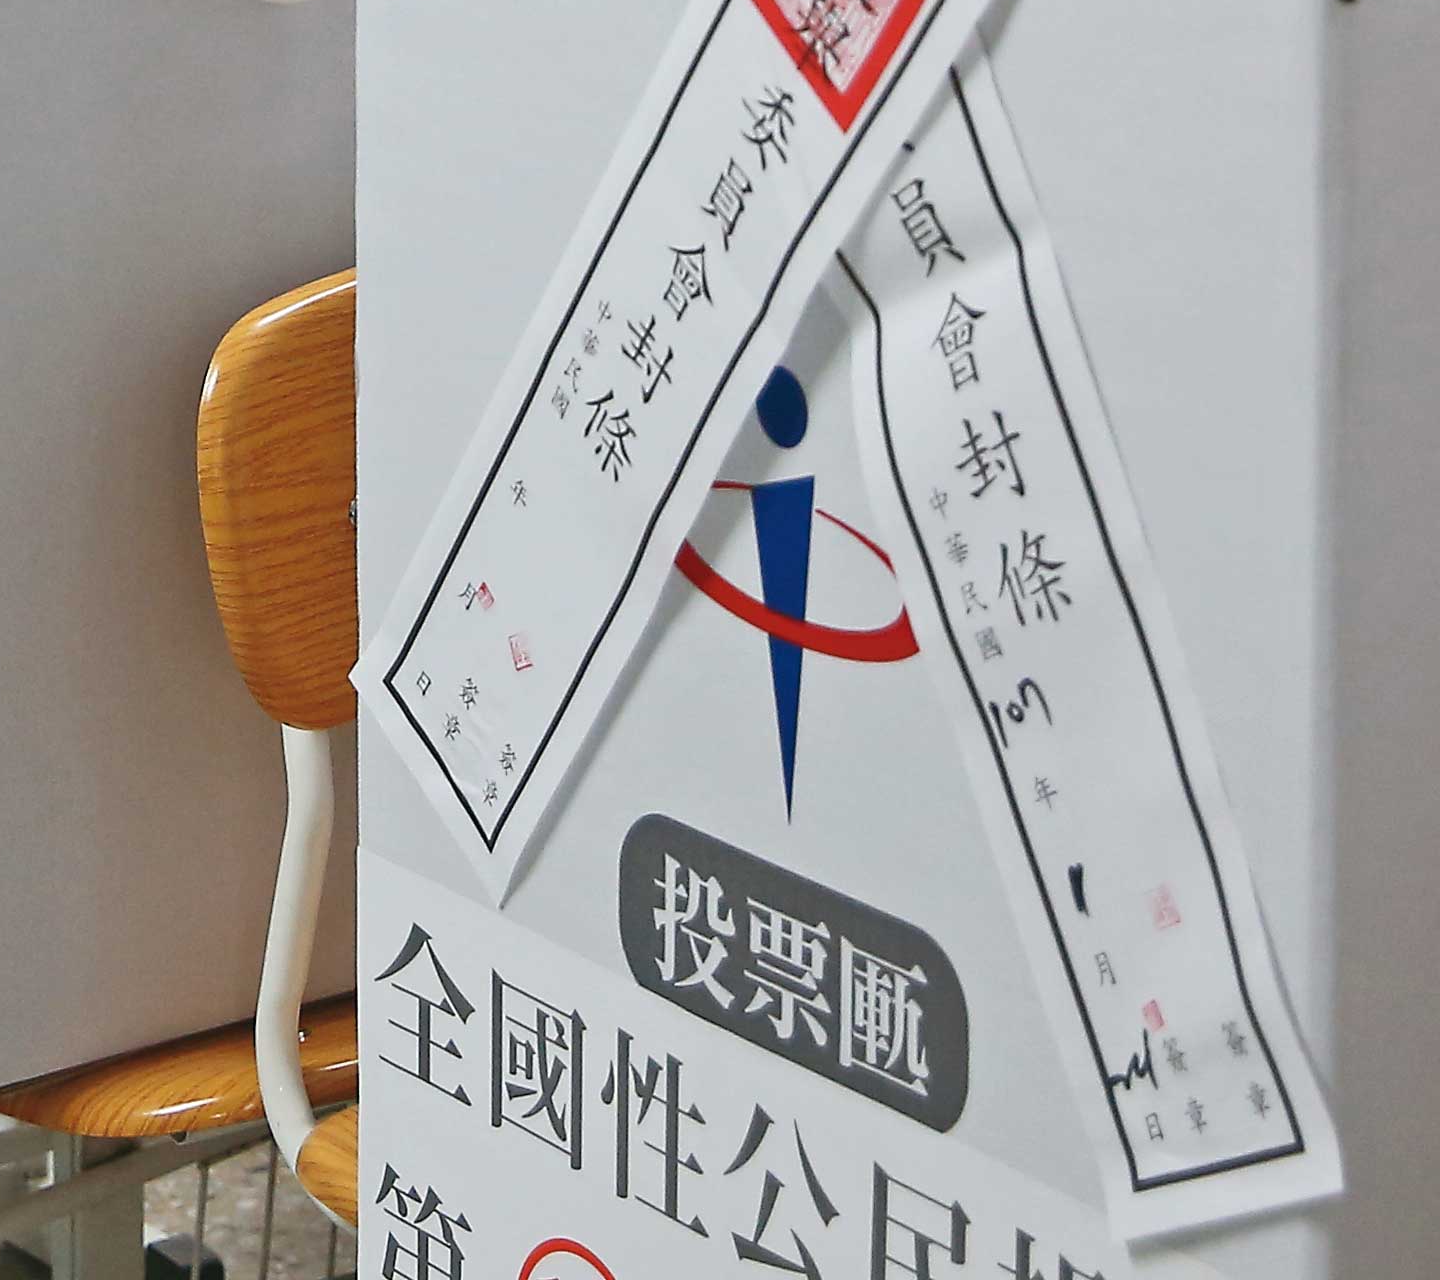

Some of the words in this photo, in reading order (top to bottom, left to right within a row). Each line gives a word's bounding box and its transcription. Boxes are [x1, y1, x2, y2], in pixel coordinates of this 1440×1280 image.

[929, 487, 1004, 661] 中華民國
[375, 921, 1108, 1280] 全國性公民
